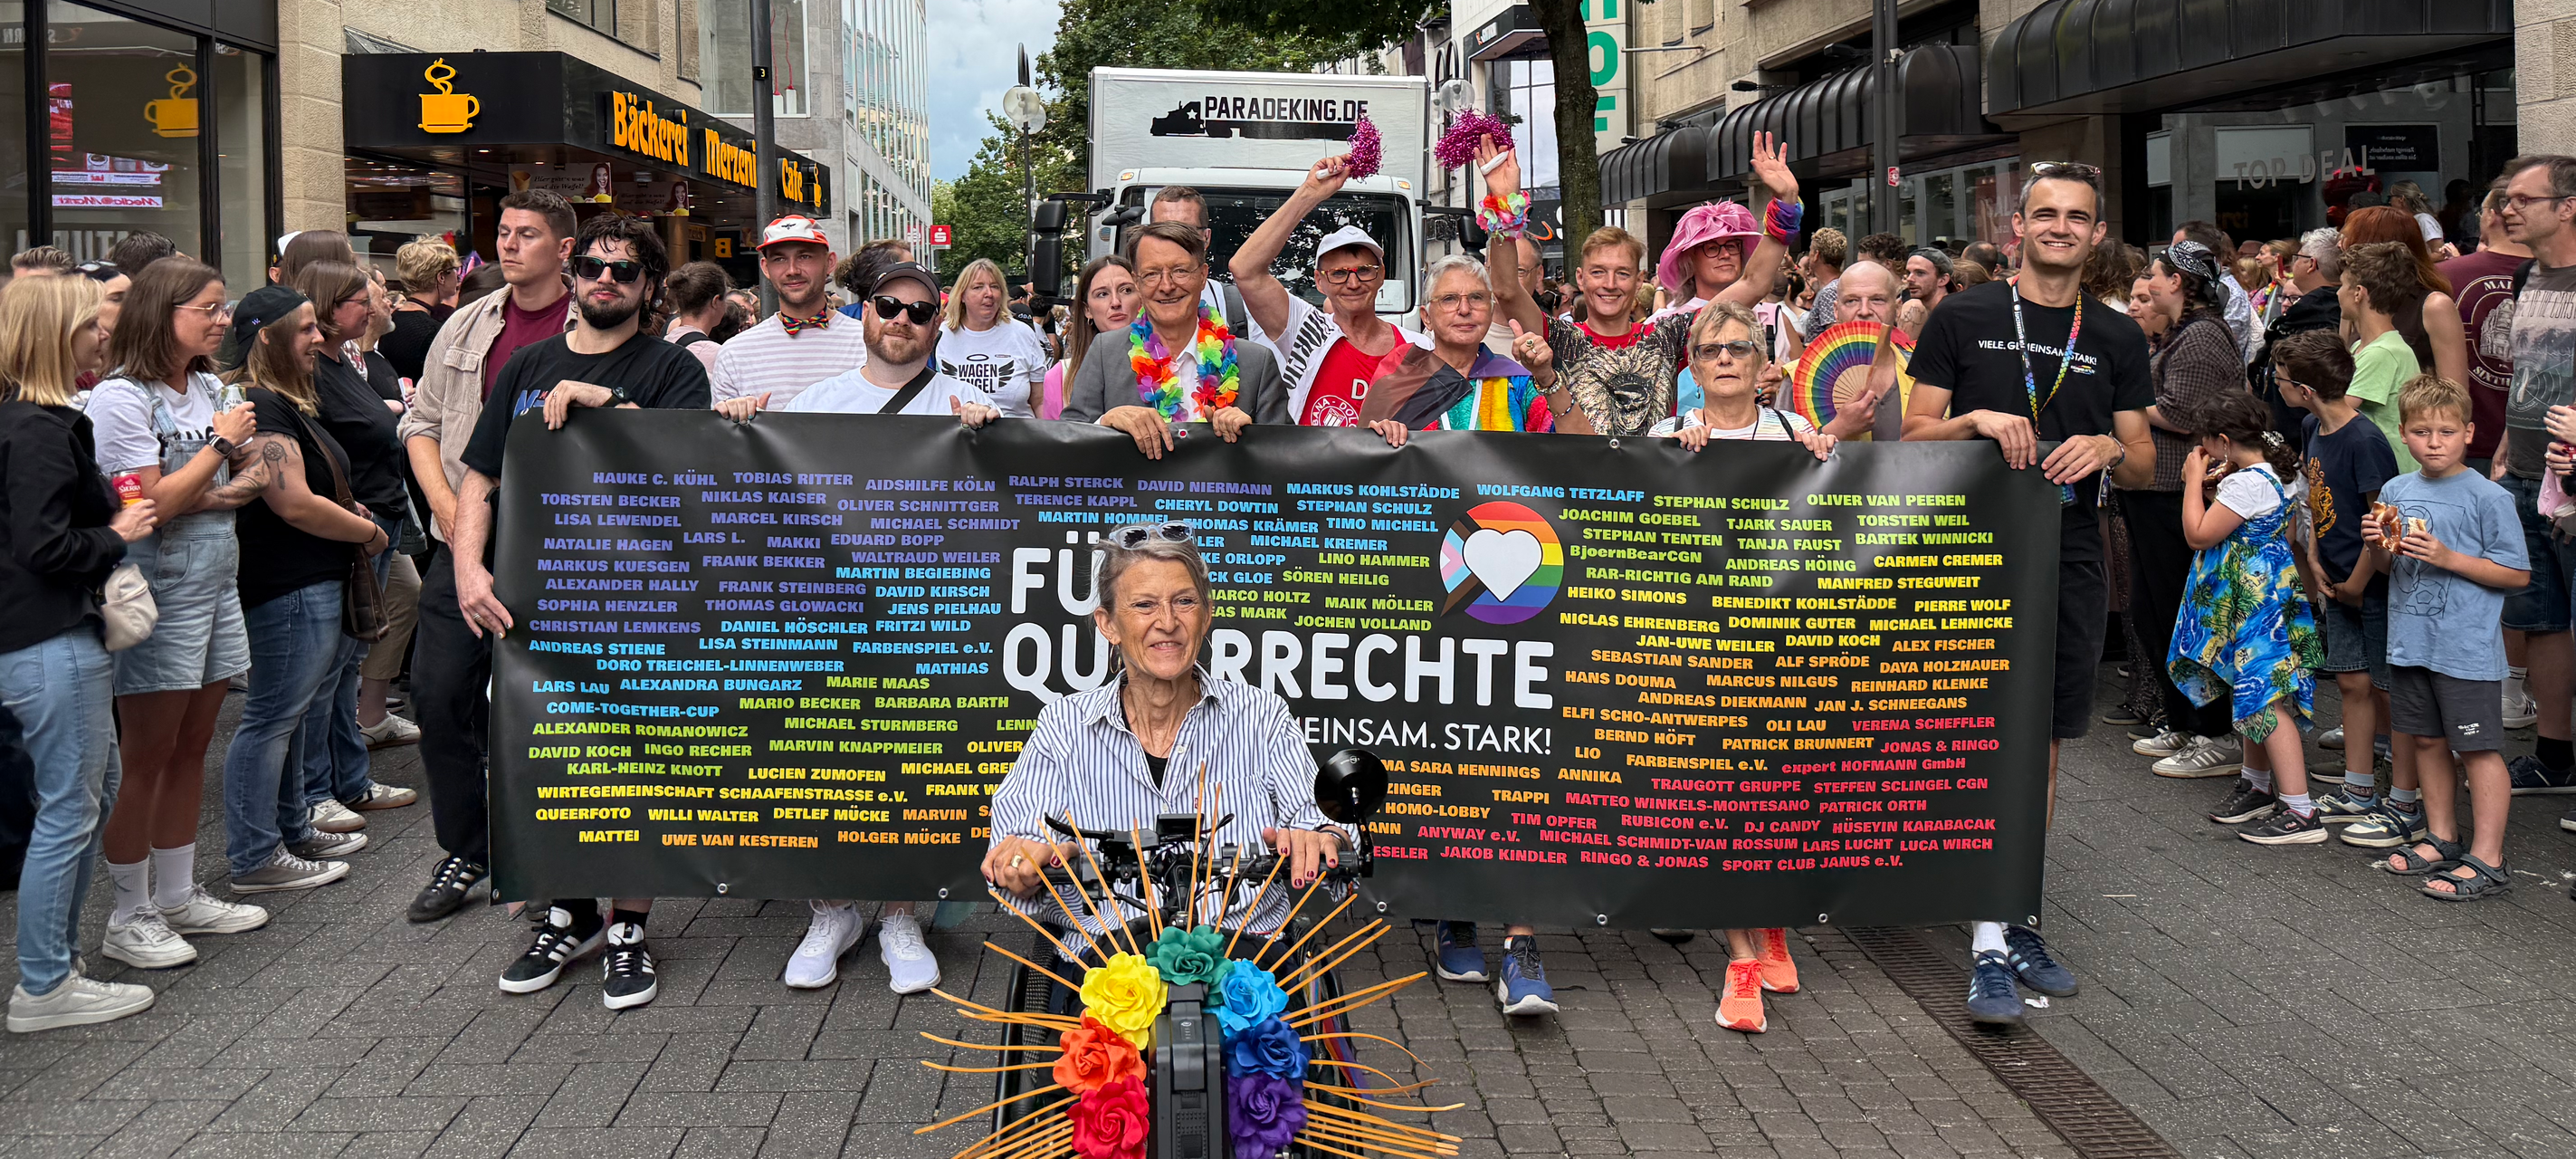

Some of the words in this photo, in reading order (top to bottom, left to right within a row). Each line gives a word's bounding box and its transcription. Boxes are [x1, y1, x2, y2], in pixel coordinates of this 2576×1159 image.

[1205, 96, 1369, 121] PARADEKING.DE
[613, 91, 689, 168] Bäckerei
[704, 128, 757, 188] Merzeni
[2233, 157, 2286, 191] TOP
[2299, 144, 2376, 184] DEAL
[1978, 340, 2007, 350] VIELE.
[959, 364, 997, 378] WAGEN
[593, 473, 646, 484] HAUKE
[652, 474, 668, 485] C.
[673, 469, 717, 486] KÜHL
[866, 479, 948, 492] AIDSHILFE
[954, 474, 996, 492] KÖLN
[701, 491, 763, 503] NIKLAS
[768, 493, 826, 504] KAISER
[1286, 483, 1354, 496] MARKUS
[1358, 484, 1460, 500] KOHLSTÄDDE
[1476, 484, 1565, 499] WOLFGANG
[1569, 487, 1646, 503] TETZLAFF
[1015, 493, 1083, 506] TERENCE
[1088, 496, 1136, 507] KAPPL
[1154, 498, 1214, 512] CHERYL
[1217, 500, 1279, 514] DOWTIN
[1807, 493, 1864, 507] OLIVER
[1866, 494, 1901, 507] VAN
[1906, 494, 1966, 507] PEEREN
[555, 513, 591, 526] LISA
[597, 514, 681, 527] LEWENDEL
[1326, 517, 1367, 531] TIMO
[1371, 519, 1439, 532] MICHELL
[683, 532, 726, 543] LARS
[731, 532, 746, 543] L.
[767, 536, 821, 549] MAKKI
[1583, 527, 1657, 543] STEPHAN
[1661, 532, 1723, 547] TENTEN
[1856, 532, 1919, 545] BARTEK
[1922, 532, 1993, 545] WINNICKI
[1569, 545, 1703, 563] BjoernBearCGN
[538, 560, 608, 572] MARKUS
[614, 560, 690, 573] KUESGEN
[1725, 558, 1800, 571] ANDREAS
[1805, 554, 1857, 572] HÖING
[835, 566, 900, 580] MARTIN
[904, 567, 991, 580] BEGIEBING
[1011, 531, 1107, 616] FÜ
[1283, 566, 1334, 584] SÖREN
[1339, 573, 1389, 586] HEILIG
[1586, 567, 1692, 585] RAR-RICHTIG
[1695, 573, 1723, 587] AM
[1729, 575, 1774, 588] RAND
[545, 578, 643, 591] ALEXANDER
[648, 580, 699, 592] HALLY
[1818, 577, 1894, 590] MANFRED
[1897, 576, 1981, 589] STEGUWEIT
[887, 603, 930, 616] JENS
[933, 603, 1002, 615] PIELHAU
[1325, 597, 1367, 609] MAIK
[1372, 593, 1434, 612] MÖLLER
[1914, 599, 1968, 613] PIERRE
[1970, 599, 2011, 612] WOLF
[720, 620, 780, 633] DANIEL
[784, 617, 869, 635] HÖSCHLER
[1294, 615, 1356, 629] JOCHEN
[1360, 618, 1432, 631] VOLLAND
[1560, 612, 1619, 627] NICLAS
[1624, 616, 1721, 634] EHRENBERG
[853, 641, 959, 655] FARBENSPIEL
[962, 642, 994, 655] e.V.
[596, 658, 643, 672] DORO
[645, 659, 844, 673] TREICHEL-LINNENWEBER
[1003, 622, 1553, 709] QURRECHTE
[1775, 656, 1805, 668] ALF
[1808, 651, 1870, 668] SPRÖDE
[826, 675, 878, 689] MARIE
[883, 677, 930, 690] MAAS
[1565, 670, 1611, 685] HANS
[1615, 673, 1677, 690] DOUMA
[1851, 679, 1929, 693] REINHARD
[1932, 677, 1989, 691] KLENKE
[546, 701, 720, 718] COME-TOGETHER-CUP
[874, 696, 952, 709] BARBARA
[956, 696, 1009, 709] BARTH
[1562, 706, 1595, 720] ELFI
[1600, 708, 1749, 728] SCHO-ANTWERPES
[1852, 719, 1911, 732] VERENA
[1914, 716, 1996, 731] SCHEFFLER
[1296, 717, 1436, 751] EINSAM.
[1443, 722, 1552, 756] STARK!
[1594, 728, 1650, 743] BERND
[1654, 728, 1697, 746] HÖFT
[529, 746, 581, 759] DAVID
[586, 745, 632, 758] KOCH
[1575, 746, 1601, 760] LIO
[1880, 741, 1932, 754] JONAS
[1935, 740, 1948, 752] &
[1951, 739, 2000, 752] RINGO
[567, 761, 666, 775] KARL-HEINZ
[670, 763, 723, 777] KNOTT
[1781, 761, 1837, 776] expert
[1841, 759, 1918, 772] HOFMANN
[1922, 757, 1967, 771] GmbH
[1557, 768, 1623, 784] ANNIKA
[537, 784, 715, 800] WIRTEGEMEINSCHAFT
[719, 787, 874, 802] SCHAAFENSTRASSE
[877, 790, 909, 803] e.V.
[1650, 778, 1736, 792] TRAUGOTT
[1739, 781, 1802, 793] GRUPPE
[1492, 789, 1550, 805] TRAPPI
[1565, 791, 1631, 808] MATTEO
[1634, 796, 1810, 812] WINKELS-MONTESANO
[535, 807, 632, 821] QUEERFOTO
[773, 807, 830, 820] DETLEF
[834, 805, 891, 822] MÜCKE
[1385, 802, 1492, 819] HOMO-LOBBY
[1511, 812, 1541, 826] TIM
[1546, 815, 1598, 830] OPFER
[1743, 821, 1765, 833] DJ
[1770, 819, 1822, 834] CANDY
[578, 829, 640, 843] MATTEI
[662, 834, 698, 847] UWE
[701, 834, 735, 847] VAN
[739, 834, 819, 849] KESTEREN
[1417, 825, 1486, 841] ANYWAY
[1490, 830, 1521, 843] e.V.
[1540, 829, 1613, 847] MICHAEL
[1617, 834, 1728, 850] SCHMIDT-VAN
[1732, 838, 1798, 850] ROSSUM
[1722, 859, 1773, 872] SPORT
[1777, 857, 1817, 871] CLUB
[1819, 855, 1871, 869] JANUS
[1874, 855, 1903, 867] e.V.
